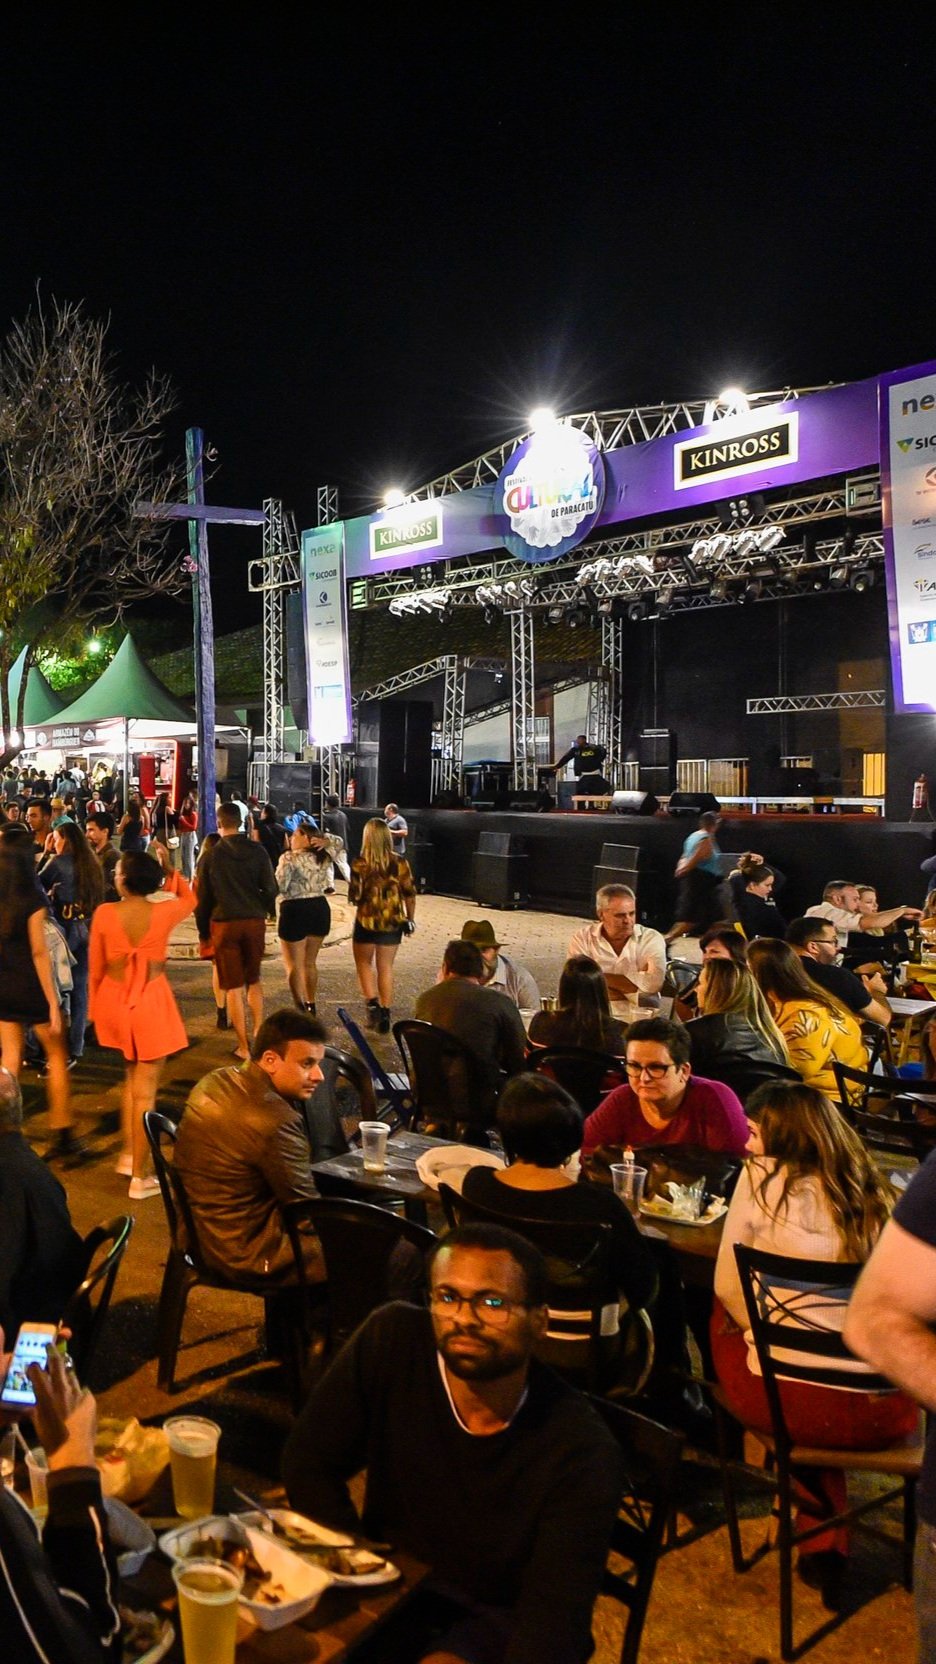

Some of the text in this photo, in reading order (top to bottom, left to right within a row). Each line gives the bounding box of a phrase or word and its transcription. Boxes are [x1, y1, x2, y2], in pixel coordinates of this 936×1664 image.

[690, 431, 780, 470] KINROSS
[551, 500, 594, 518] DE PARACATU
[379, 521, 433, 546] KINROSS
